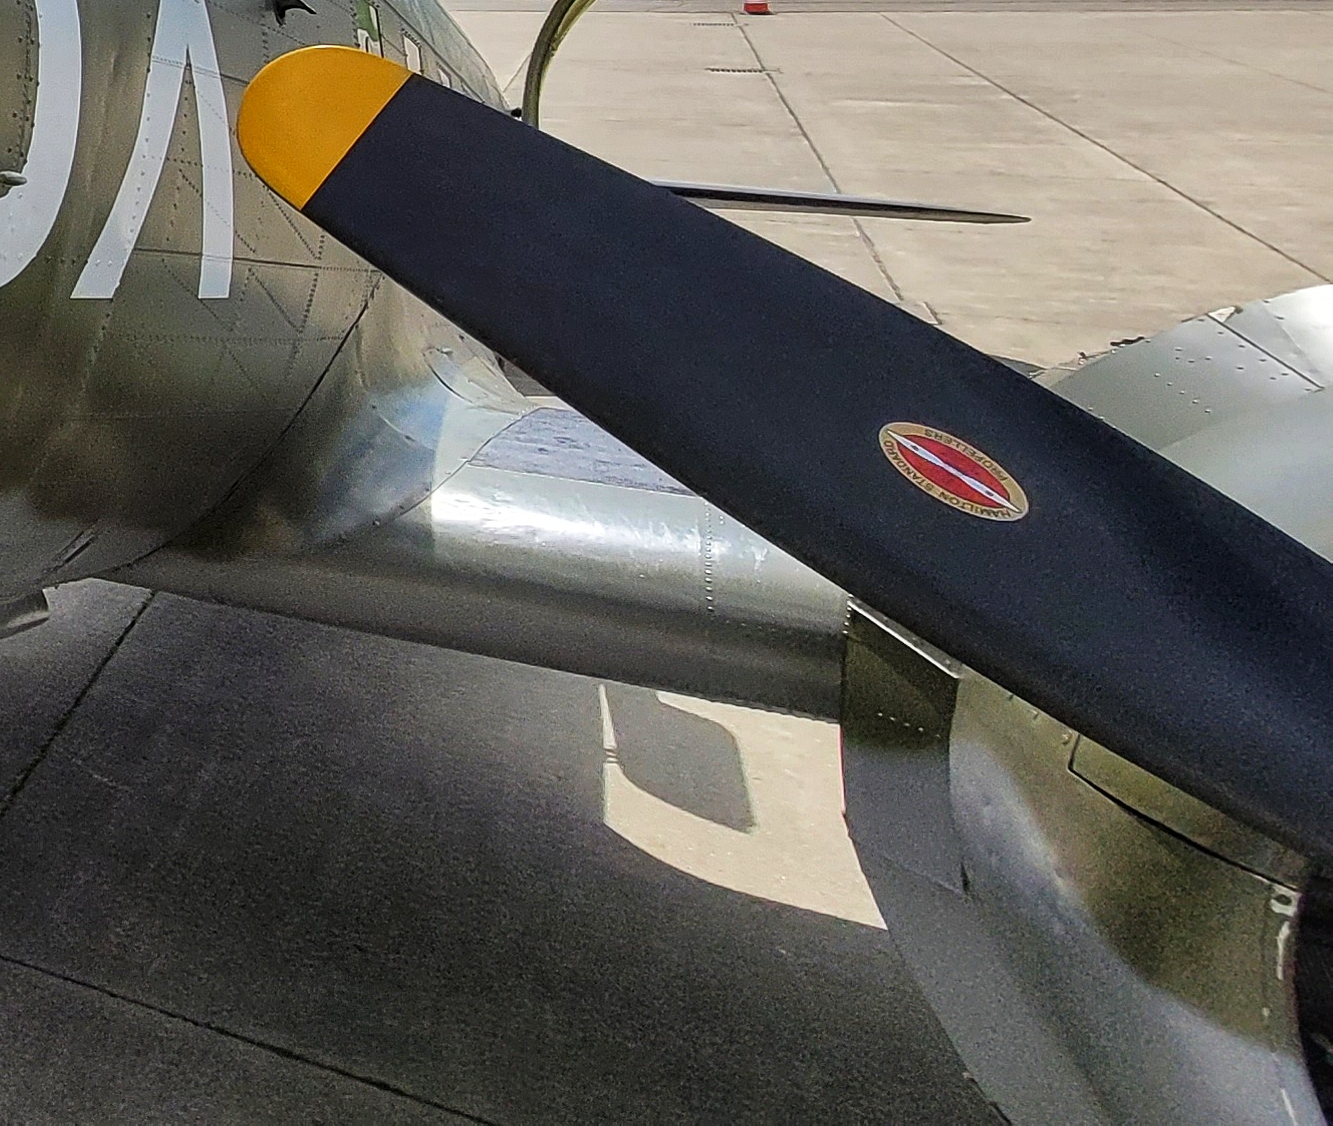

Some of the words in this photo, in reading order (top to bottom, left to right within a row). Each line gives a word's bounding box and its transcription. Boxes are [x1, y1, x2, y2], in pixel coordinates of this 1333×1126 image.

[884, 439, 933, 492] STANDARD
[924, 428, 1008, 483] PROPELLERS
[937, 490, 1011, 518] HAMILTON
